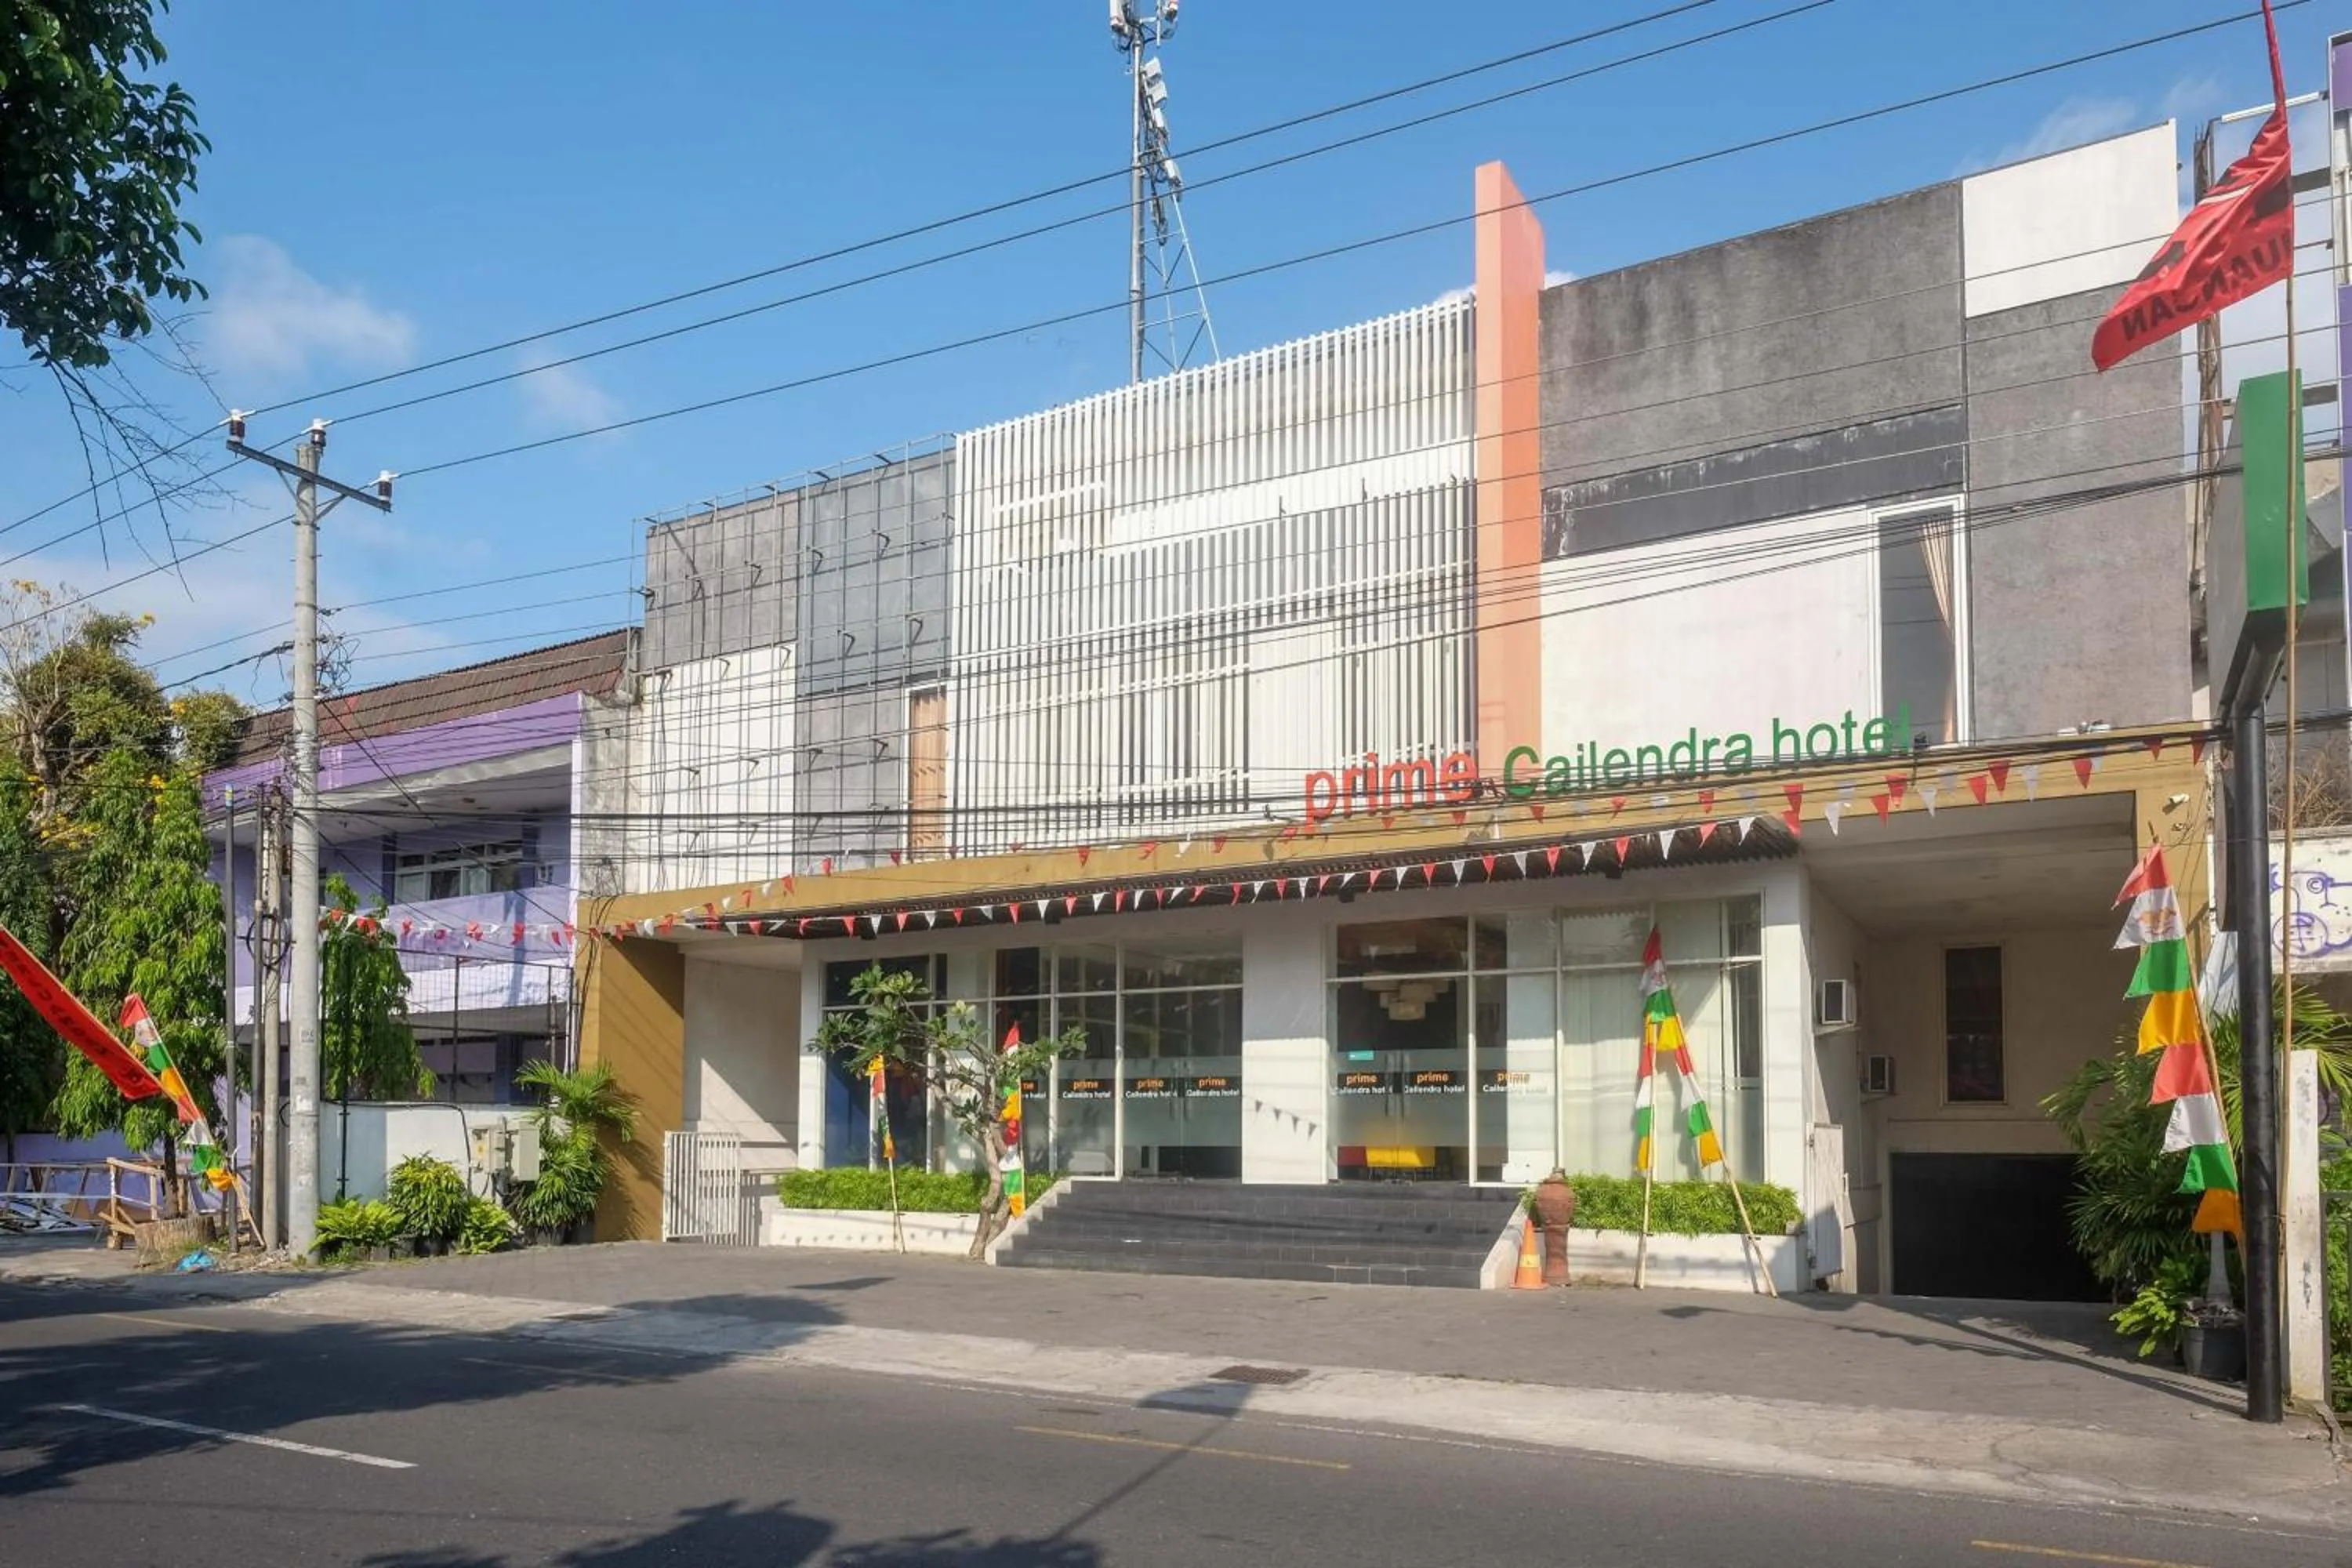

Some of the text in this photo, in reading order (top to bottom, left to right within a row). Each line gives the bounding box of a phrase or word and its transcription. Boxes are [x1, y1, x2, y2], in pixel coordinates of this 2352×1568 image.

[1305, 700, 1911, 834] prime Cailendra hotel
[1198, 1075, 1227, 1089] prime
[1346, 1073, 1377, 1086] prime
[1417, 1072, 1449, 1084] prime
[1371, 1085, 1393, 1094] hotl
